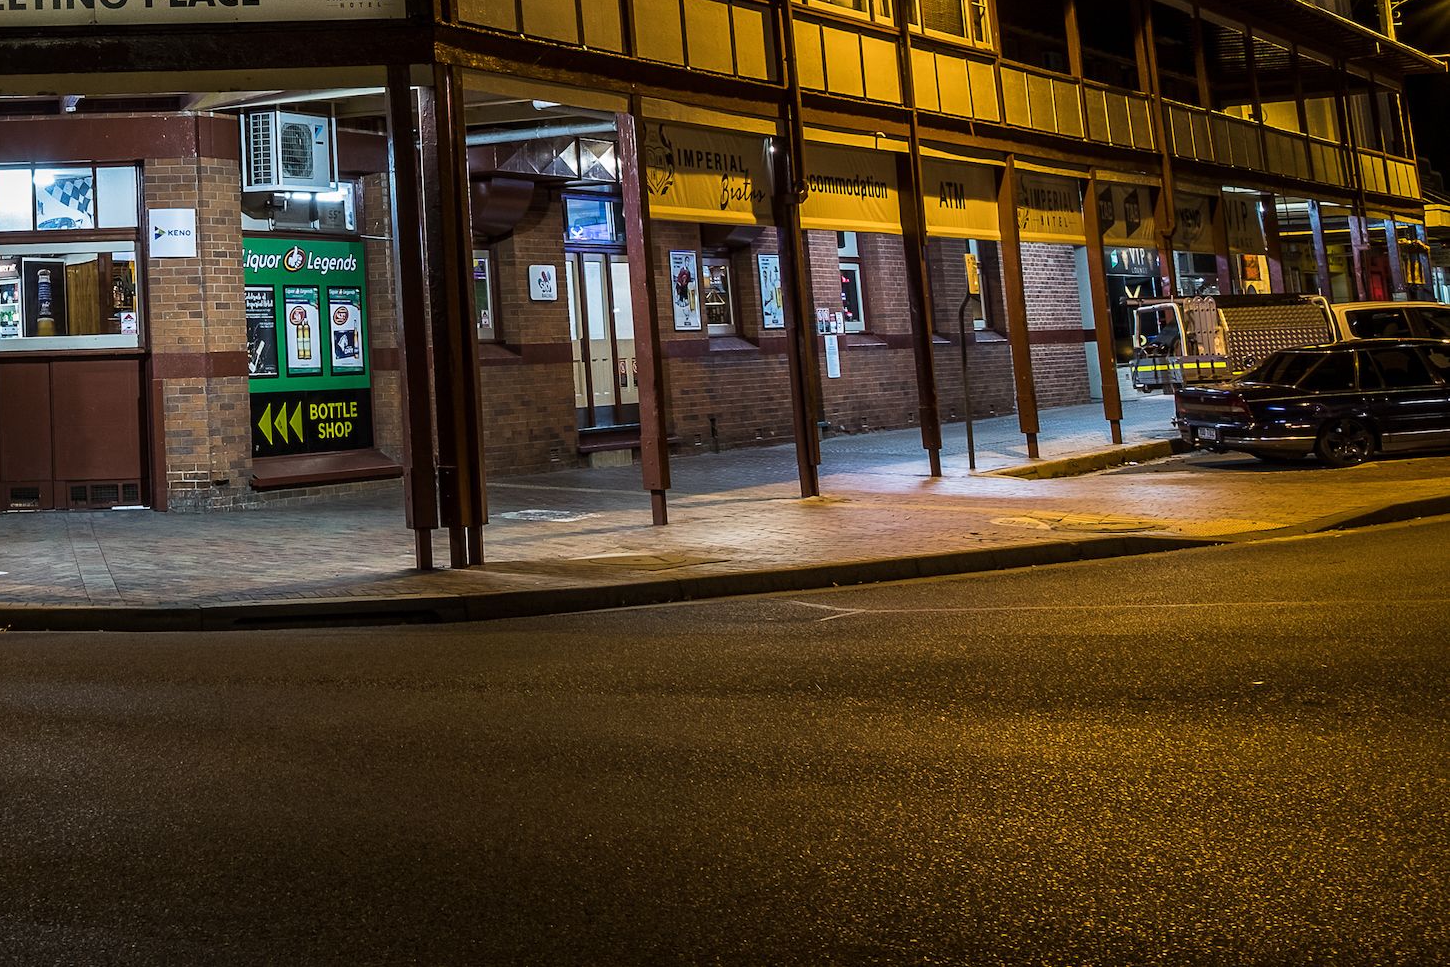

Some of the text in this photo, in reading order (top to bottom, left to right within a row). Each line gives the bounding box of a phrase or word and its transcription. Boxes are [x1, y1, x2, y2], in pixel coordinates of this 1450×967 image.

[677, 148, 749, 173] IMPERIAL
[939, 181, 966, 210] ATM
[167, 229, 192, 237] KENO
[307, 251, 357, 275] Legends
[1129, 247, 1145, 265] VIP
[310, 402, 358, 420] BOTTLE
[318, 422, 352, 439] SHOP
